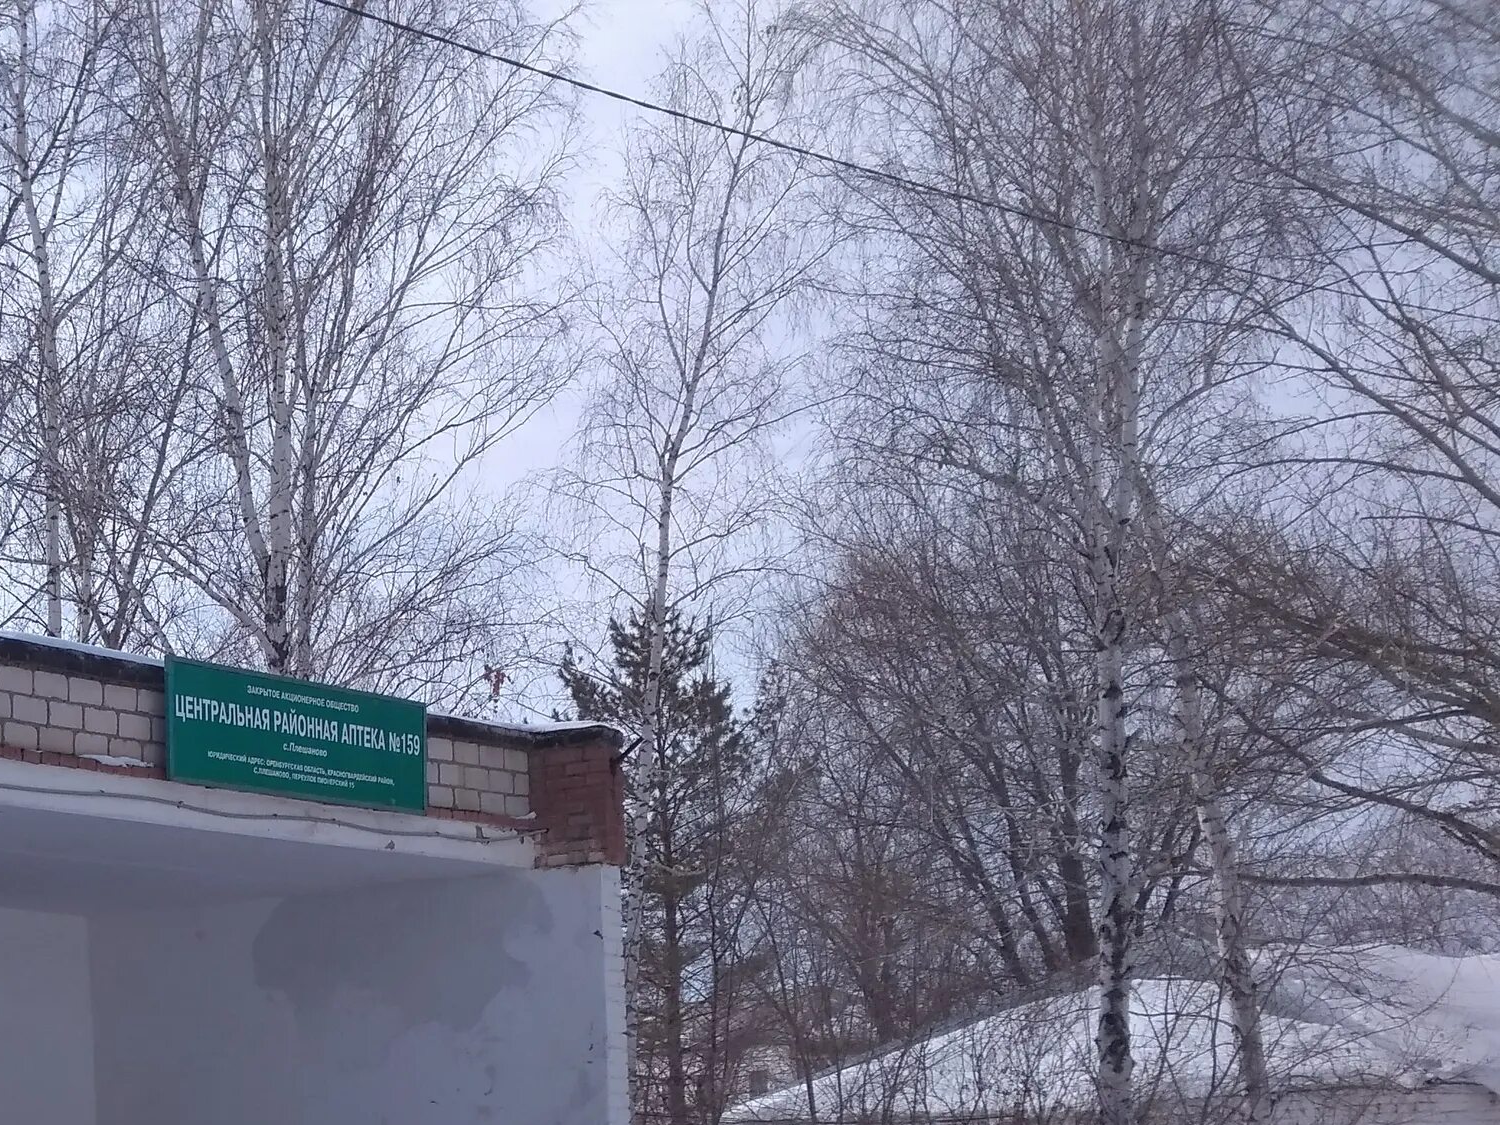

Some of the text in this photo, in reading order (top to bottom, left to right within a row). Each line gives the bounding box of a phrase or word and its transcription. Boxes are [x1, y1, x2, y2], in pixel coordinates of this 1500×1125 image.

[246, 685, 359, 713] ЗАКРЫТОЕ АКЦИОНЕРНОЕ ОБЩЕСТВО
[175, 693, 421, 756] ЦЕНТРАЛЬНАЯ РАЙОННАЯ АПТЕКА №159
